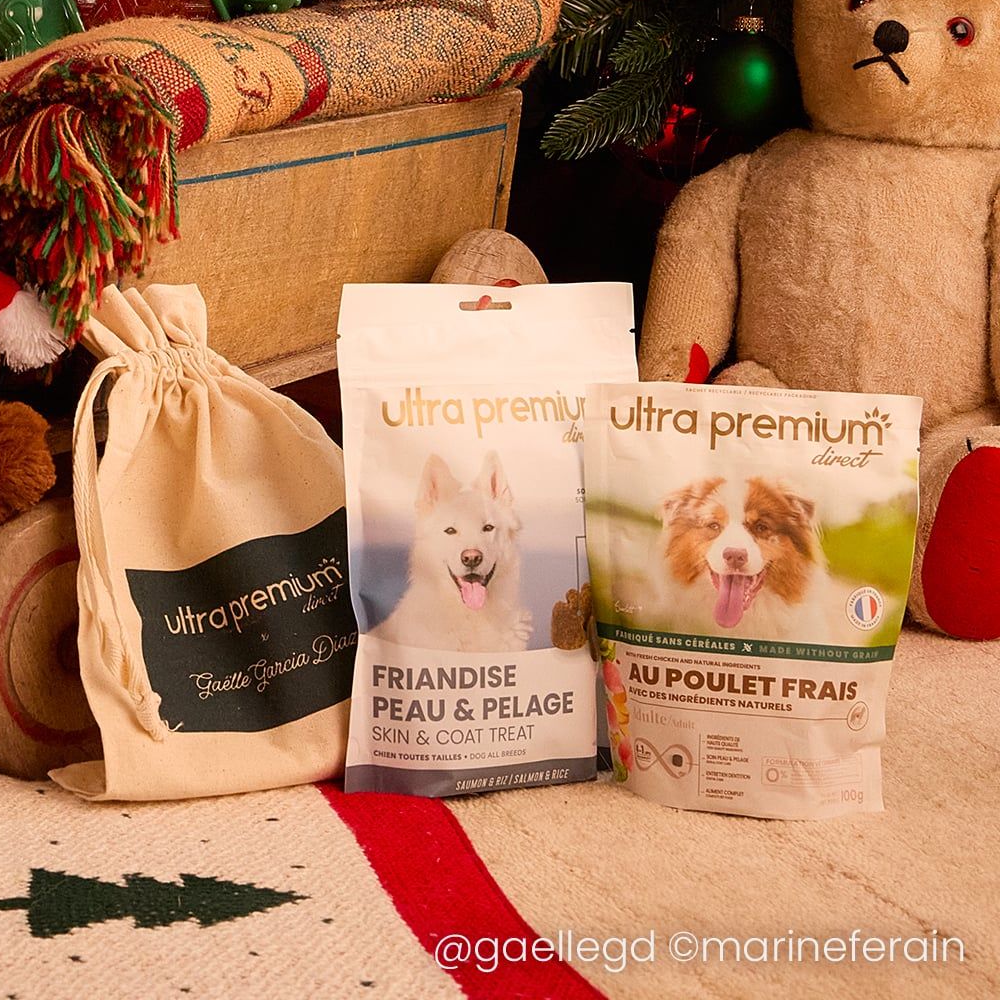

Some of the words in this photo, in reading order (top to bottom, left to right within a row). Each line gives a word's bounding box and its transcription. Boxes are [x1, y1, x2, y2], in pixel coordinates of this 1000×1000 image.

[381, 387, 465, 428] ultra
[472, 390, 586, 439] premiu
[610, 396, 698, 435] ultra
[710, 411, 883, 450] premium
[562, 422, 585, 443] dir
[811, 446, 883, 468] direct
[163, 605, 228, 635] ultra
[228, 564, 344, 634] premium
[616, 629, 654, 643] FABRIQUÉ
[656, 635, 682, 646] SANS
[685, 638, 736, 651] CÉRÉALES
[759, 645, 793, 656] MADE
[795, 648, 850, 659] WITHOUT
[189, 669, 252, 700] Gaëlle
[247, 651, 310, 693] Garcia
[311, 631, 357, 665] Diaz
[372, 664, 517, 691] FRIANDISE
[694, 659, 721, 667] NATURAL
[722, 662, 761, 670] INGREDIENTS
[629, 663, 659, 684] AU
[665, 668, 777, 697] POULET
[781, 678, 857, 701] FRAIS
[372, 696, 445, 723] PEAU
[453, 698, 475, 722] &
[482, 691, 574, 720] PELAGE
[628, 686, 649, 699] AVEC
[649, 690, 667, 700] DES
[668, 693, 736, 708] INGRÉDIENTS
[737, 700, 792, 712] NATURELS
[372, 726, 410, 745] SKIN
[416, 730, 430, 746] &
[436, 728, 484, 745] COAT
[489, 725, 535, 742] TREAT
[373, 750, 397, 760] CHIEN
[398, 752, 430, 761] TOUTES
[431, 753, 462, 761] TAILLES
[487, 750, 501, 758] ALL
[501, 749, 526, 758] BREEDS
[456, 777, 488, 791] SAUMON
[489, 777, 495, 786] &
[496, 776, 509, 786] RIZ
[513, 772, 544, 784] SALMON
[544, 771, 551, 780] &
[551, 768, 570, 779] RICE
[841, 790, 864, 804] 100g
